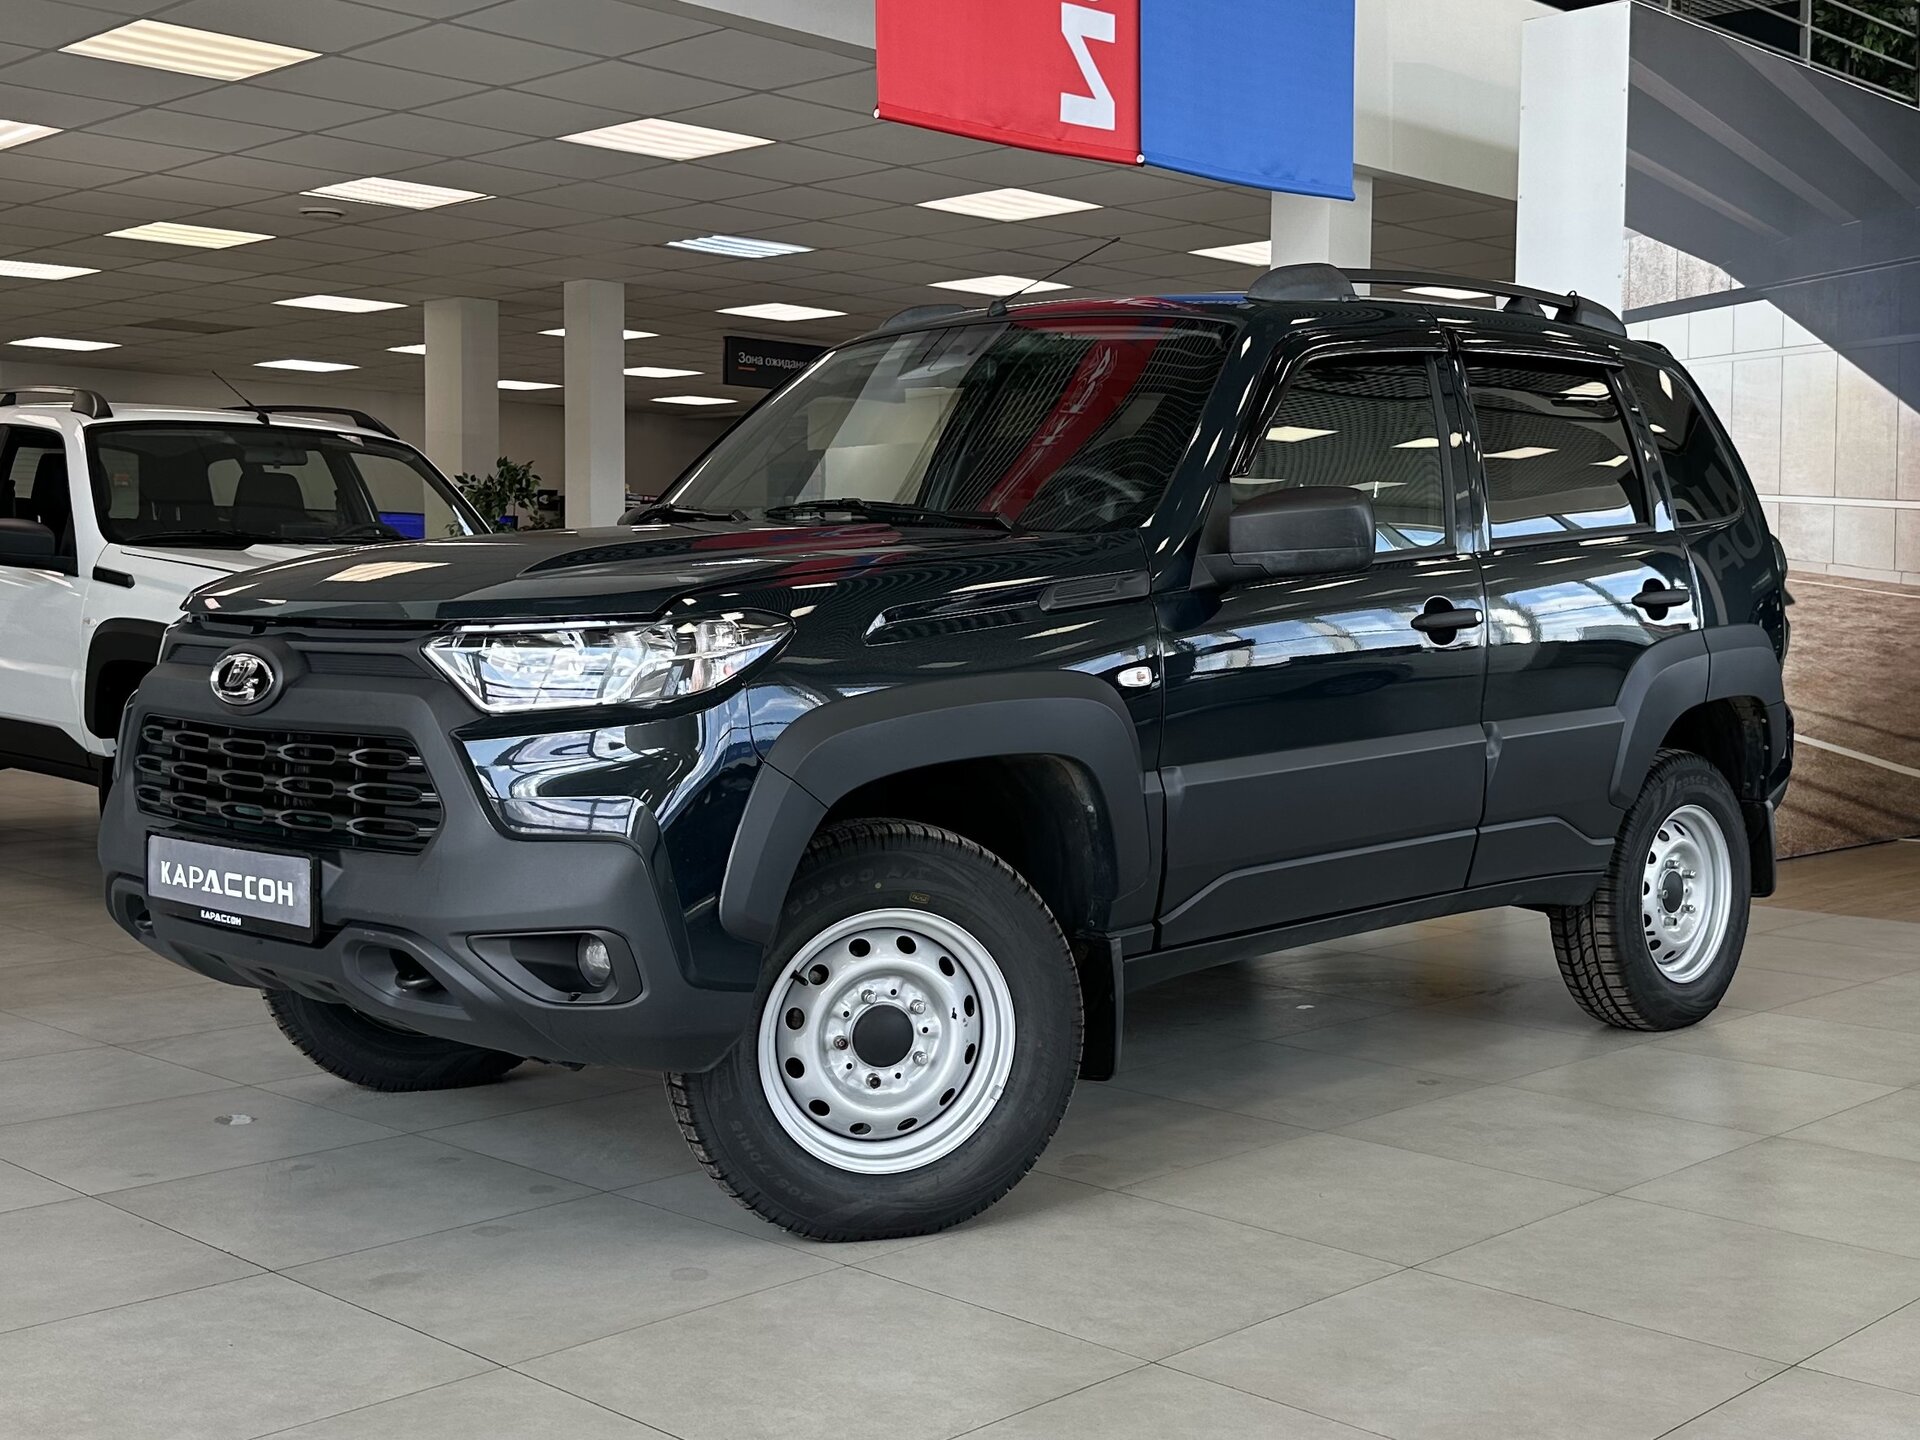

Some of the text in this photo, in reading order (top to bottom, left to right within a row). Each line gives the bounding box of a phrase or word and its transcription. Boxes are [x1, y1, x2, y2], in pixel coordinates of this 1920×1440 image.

[738, 351, 764, 364] Зона
[160, 860, 294, 907] КАРАССОН
[200, 909, 242, 926] КАРАССОН
